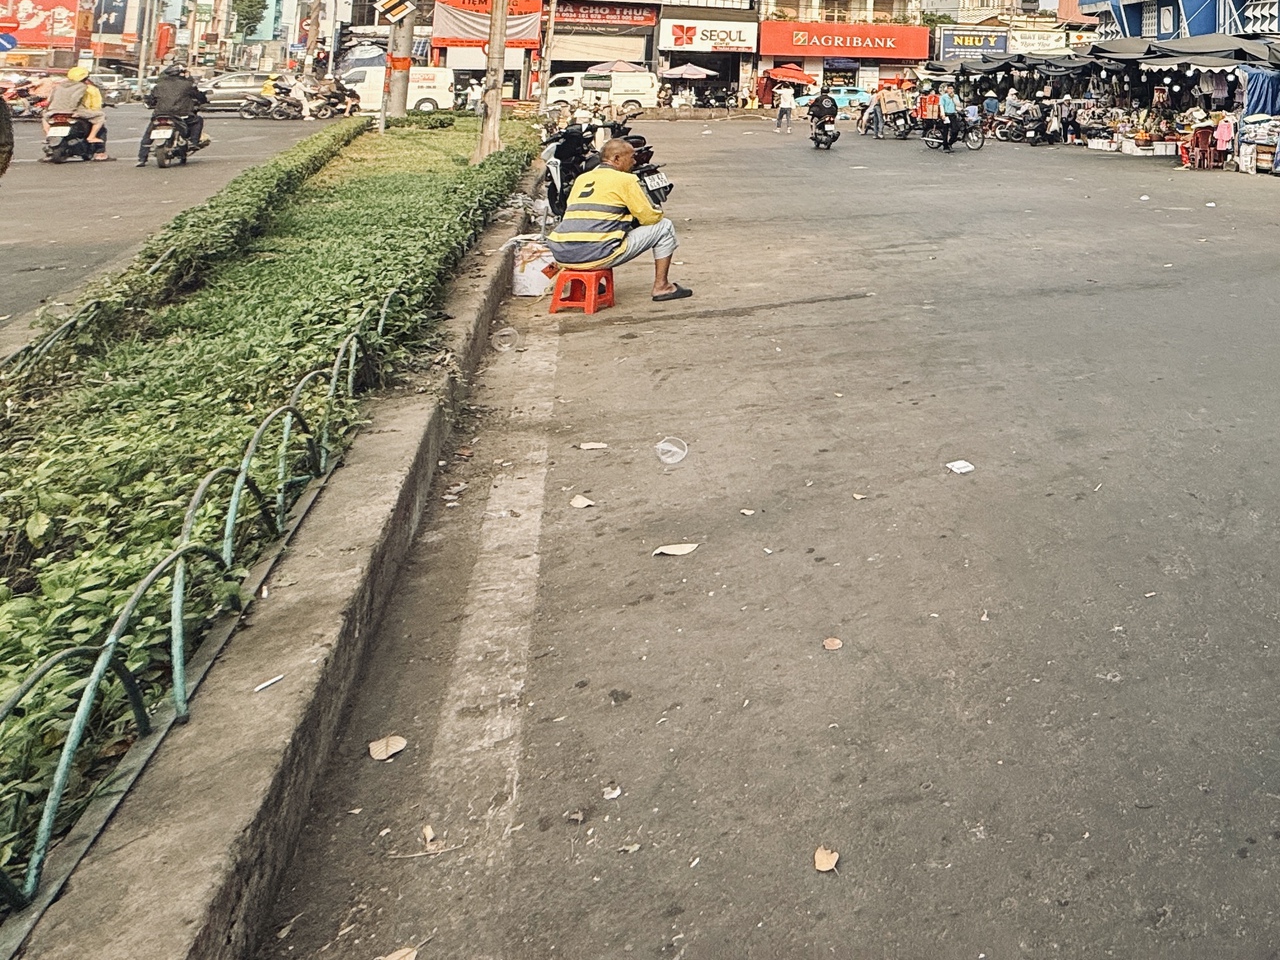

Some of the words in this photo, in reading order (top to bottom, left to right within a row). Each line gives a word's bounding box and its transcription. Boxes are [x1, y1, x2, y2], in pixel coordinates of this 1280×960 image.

[580, 5, 609, 15] CHO
[700, 29, 746, 42] SEOUL
[953, 35, 985, 47] NHƯ
[809, 35, 897, 49] AGRIBANK
